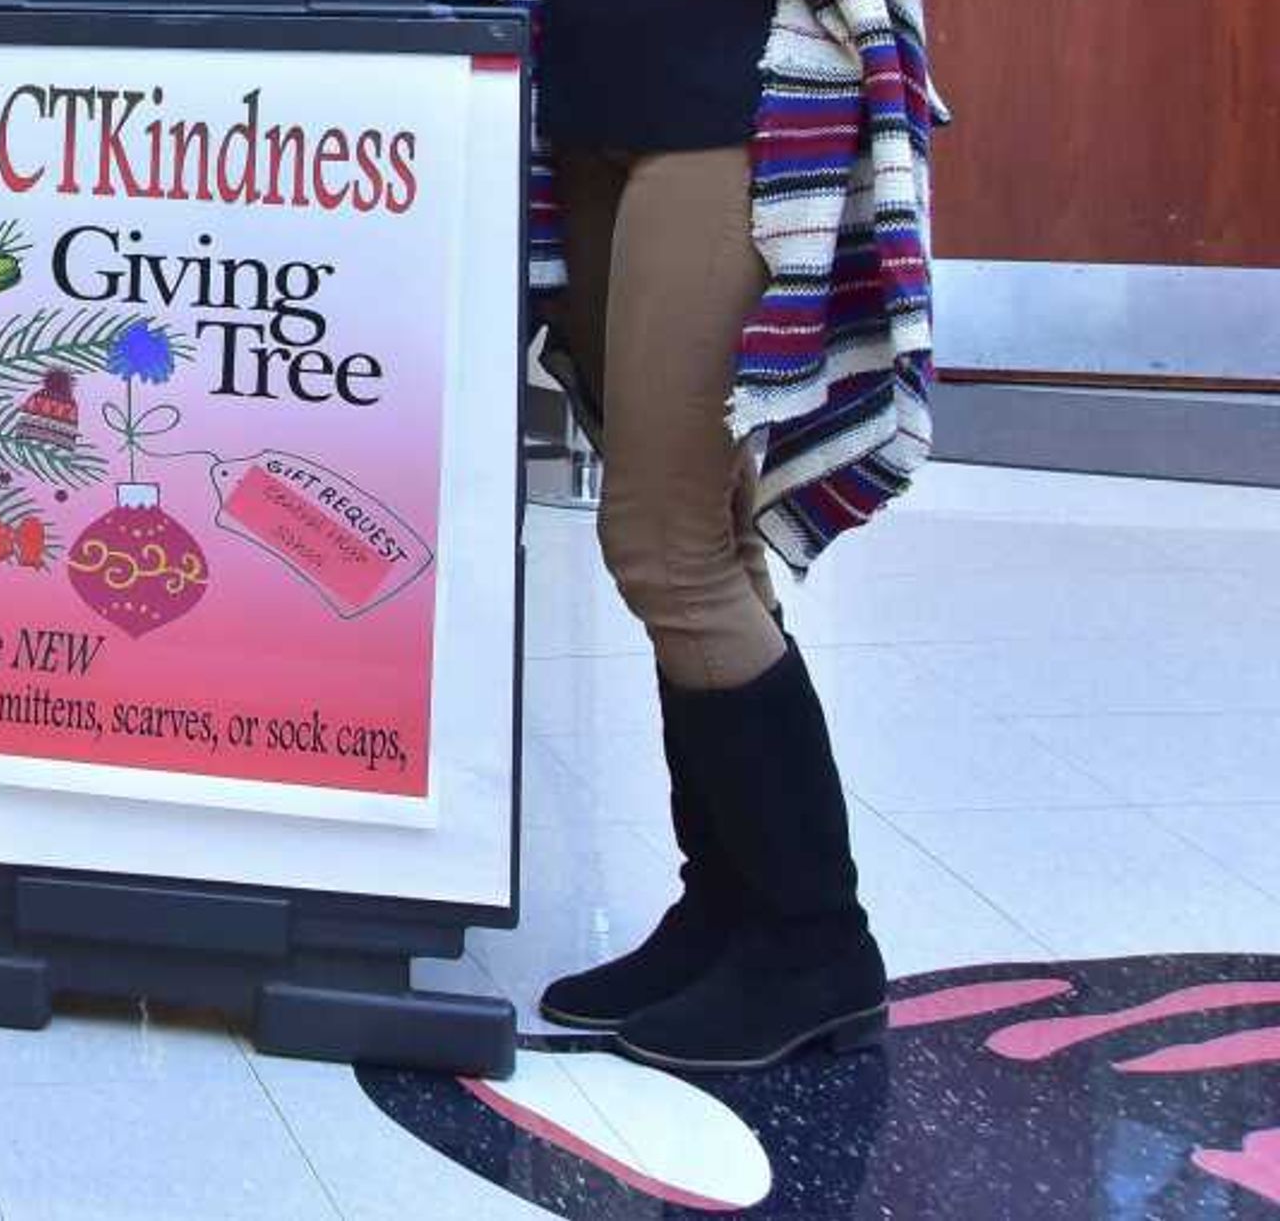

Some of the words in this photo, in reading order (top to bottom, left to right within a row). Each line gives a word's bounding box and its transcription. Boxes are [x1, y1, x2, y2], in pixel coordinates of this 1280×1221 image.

[52, 225, 336, 348] Giving
[195, 320, 383, 406] Tree
[267, 460, 322, 490] GIFT
[318, 486, 408, 564] REQUEST
[11, 628, 107, 677] NEW
[111, 703, 219, 754] scarves,
[228, 713, 259, 747] or
[266, 711, 328, 753] sock
[336, 725, 408, 772] caps,
